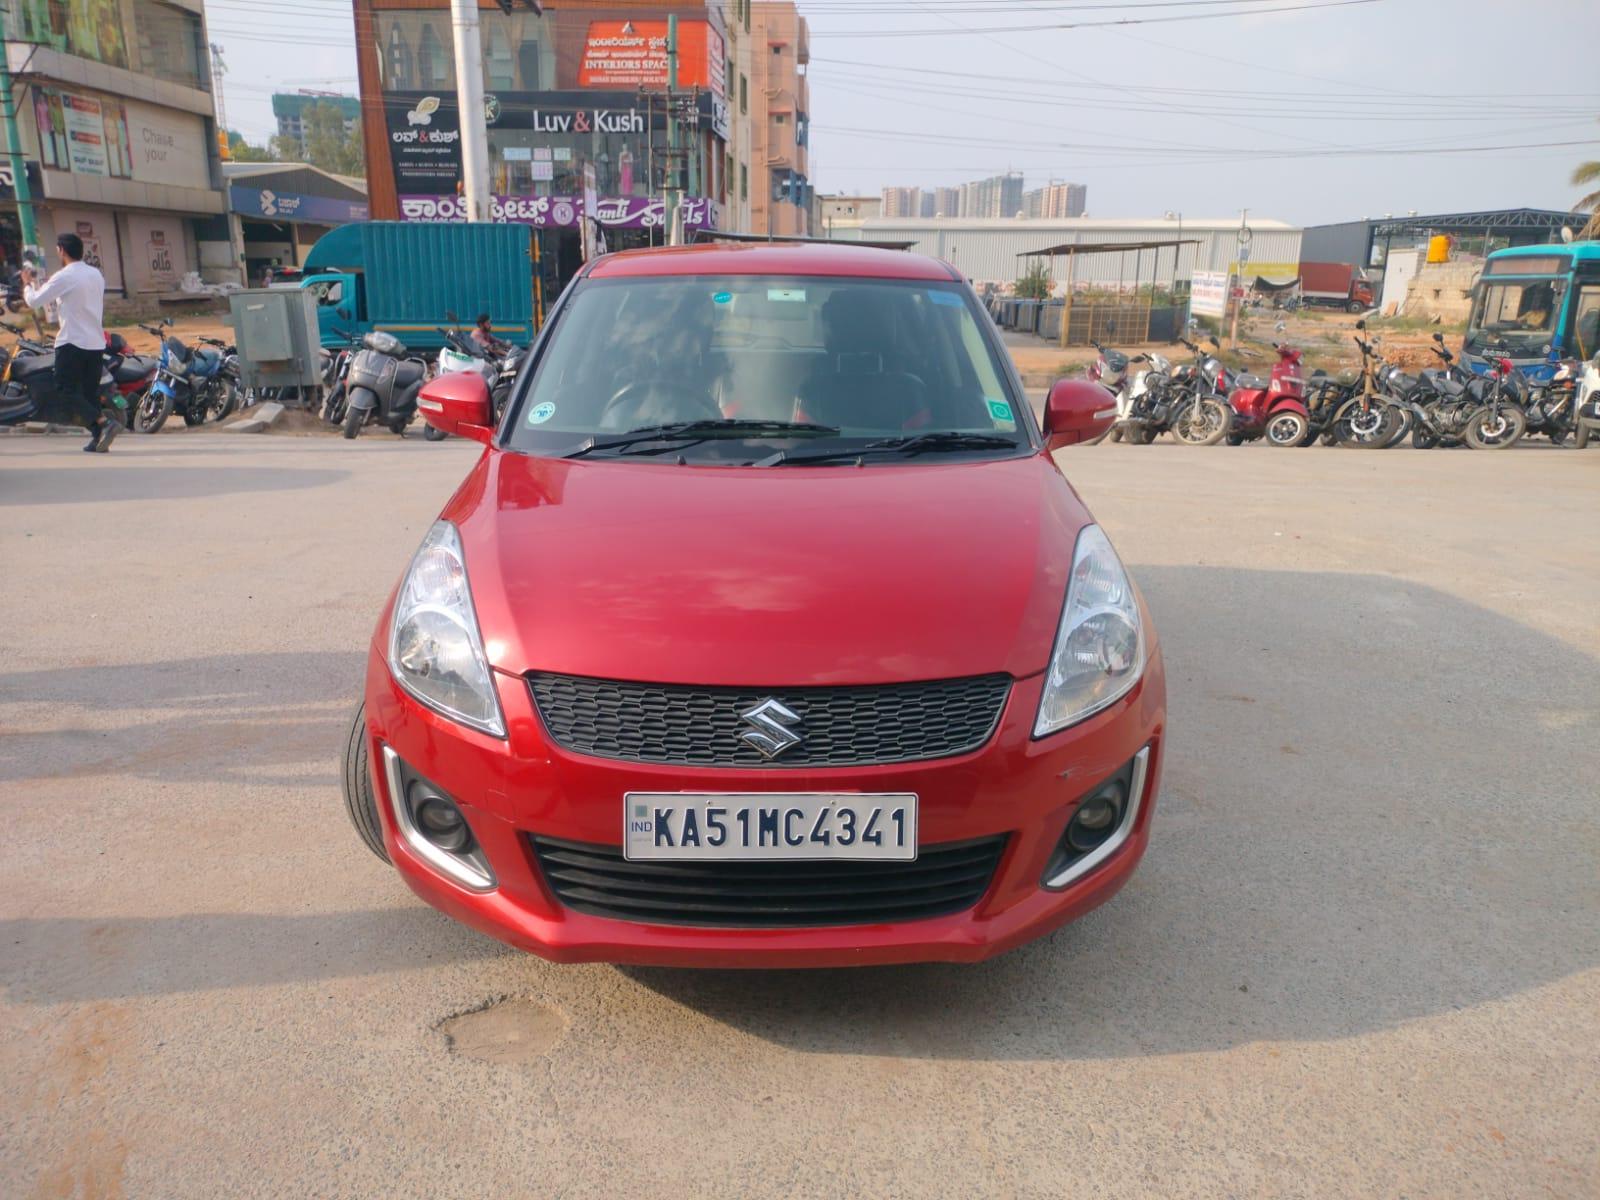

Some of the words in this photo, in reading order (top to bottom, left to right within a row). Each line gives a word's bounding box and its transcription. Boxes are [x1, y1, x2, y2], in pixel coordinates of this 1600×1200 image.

[585, 60, 641, 70] INTERIORS
[642, 60, 679, 70] SPAC
[533, 109, 571, 132] Luv
[573, 111, 590, 132] &
[593, 108, 644, 132] Kush
[142, 128, 174, 146] Chase
[419, 130, 429, 144] &
[144, 147, 168, 162] your
[631, 820, 652, 833] IND
[653, 807, 906, 847] KA51MC4341
